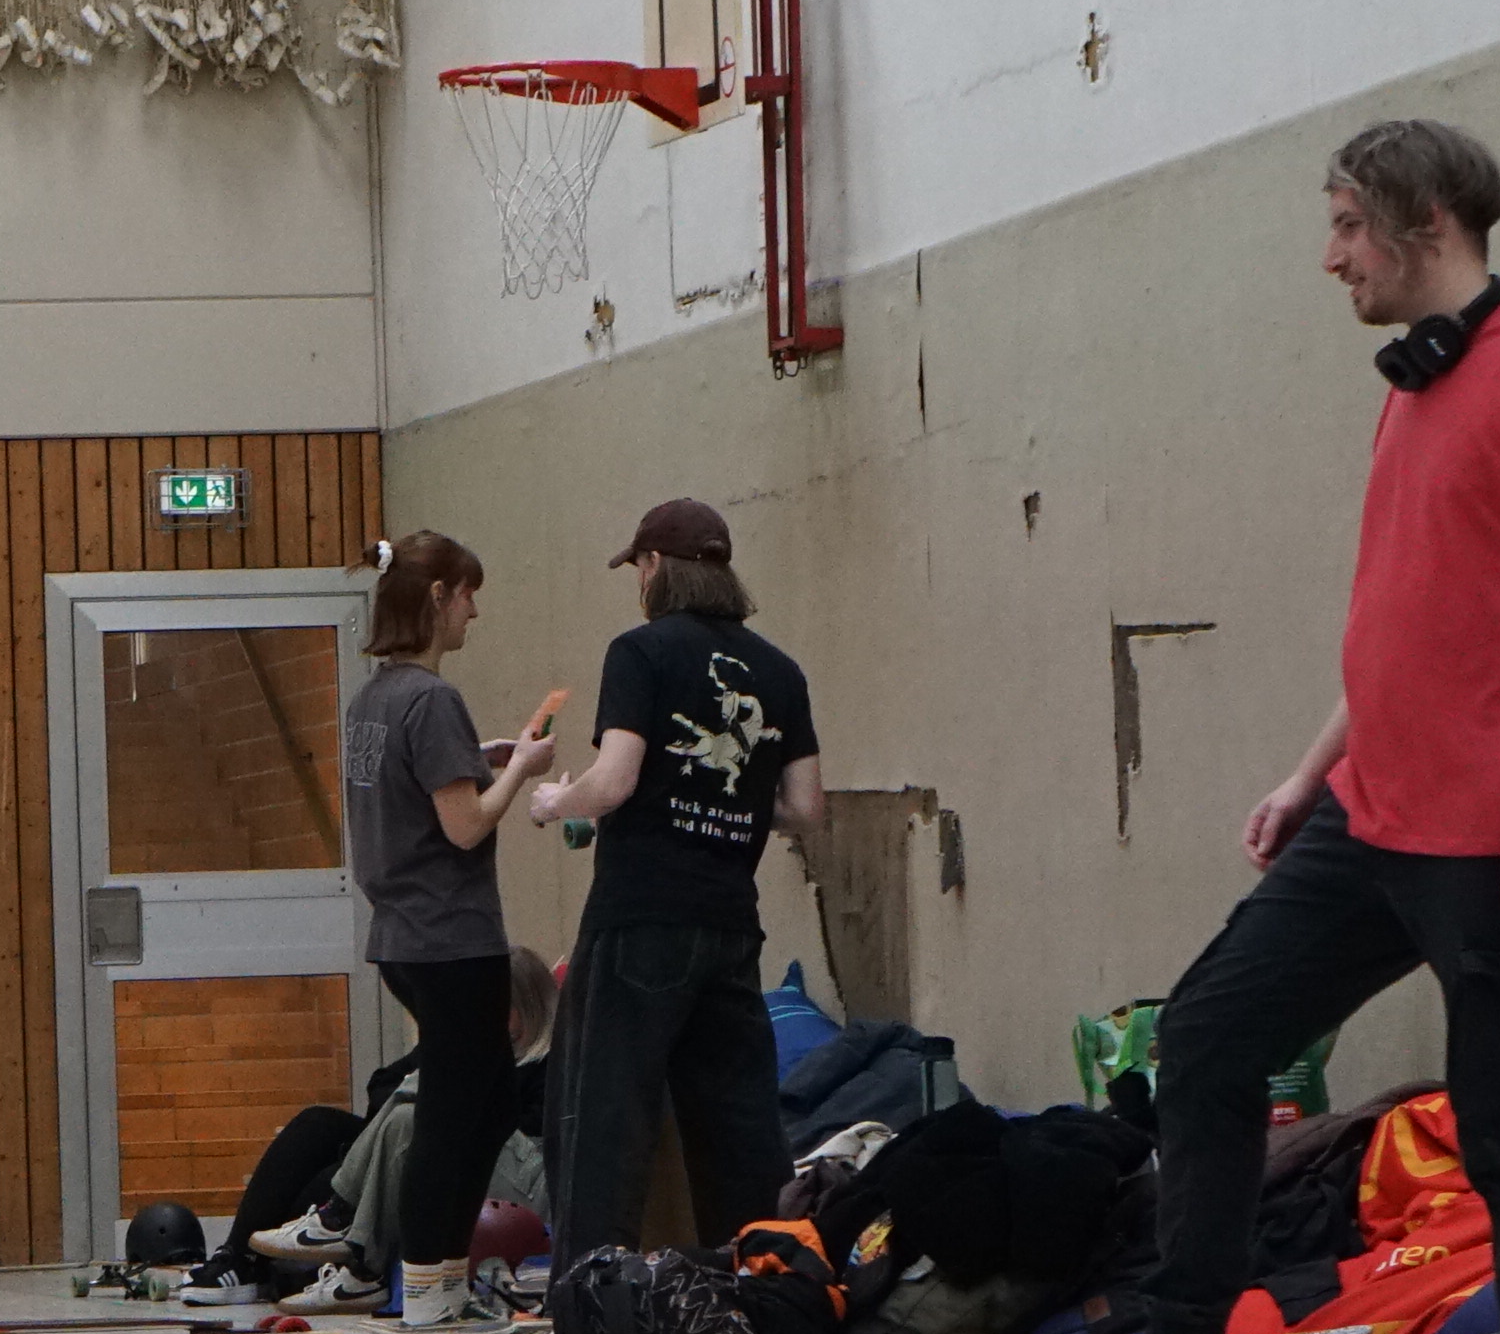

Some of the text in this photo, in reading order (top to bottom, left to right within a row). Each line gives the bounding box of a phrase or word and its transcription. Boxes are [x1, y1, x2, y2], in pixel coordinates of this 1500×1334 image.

[670, 797, 753, 825] Fuck arund
[701, 822, 726, 838] fin
[730, 831, 752, 844] out
